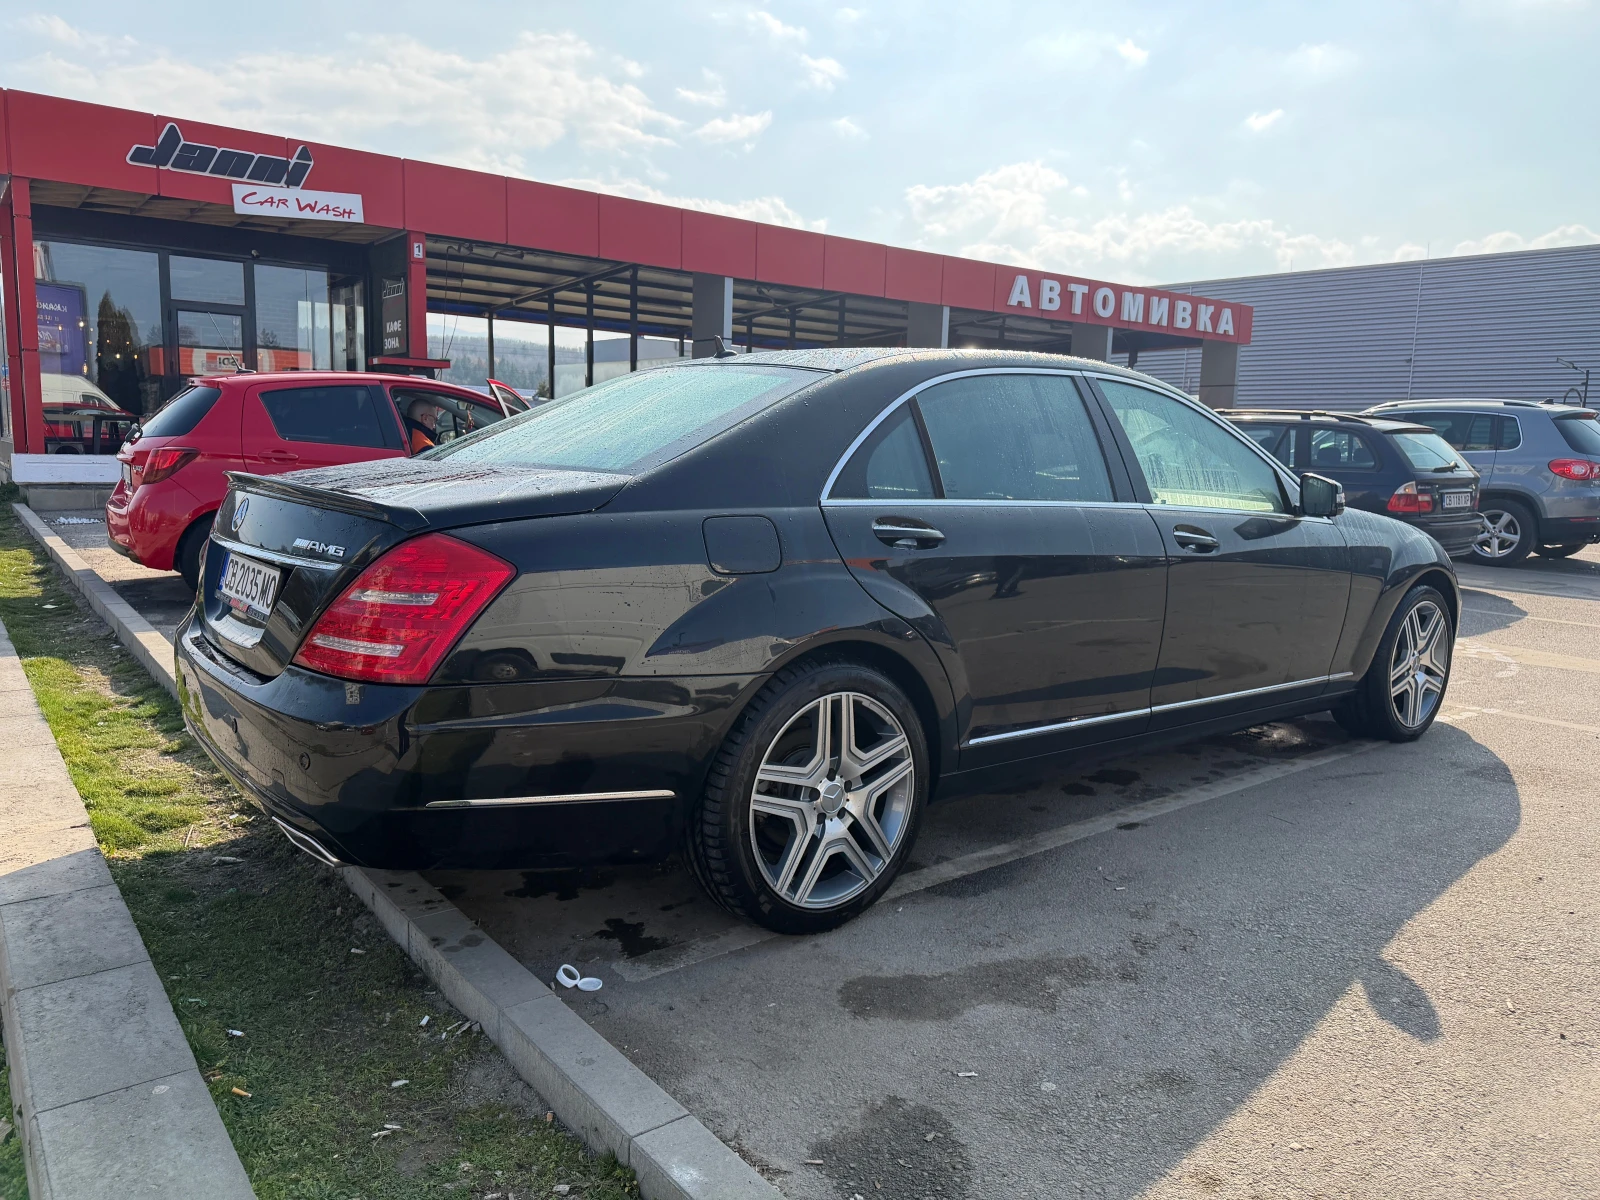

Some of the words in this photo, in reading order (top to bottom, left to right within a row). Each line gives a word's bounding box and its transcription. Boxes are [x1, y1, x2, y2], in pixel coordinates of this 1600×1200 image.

[126, 122, 314, 189] Janni
[1007, 274, 1235, 336] АВТОМИВКА
[386, 320, 401, 333] КАФЕ
[384, 337, 399, 349] ЗОНА
[306, 541, 346, 557] AMG
